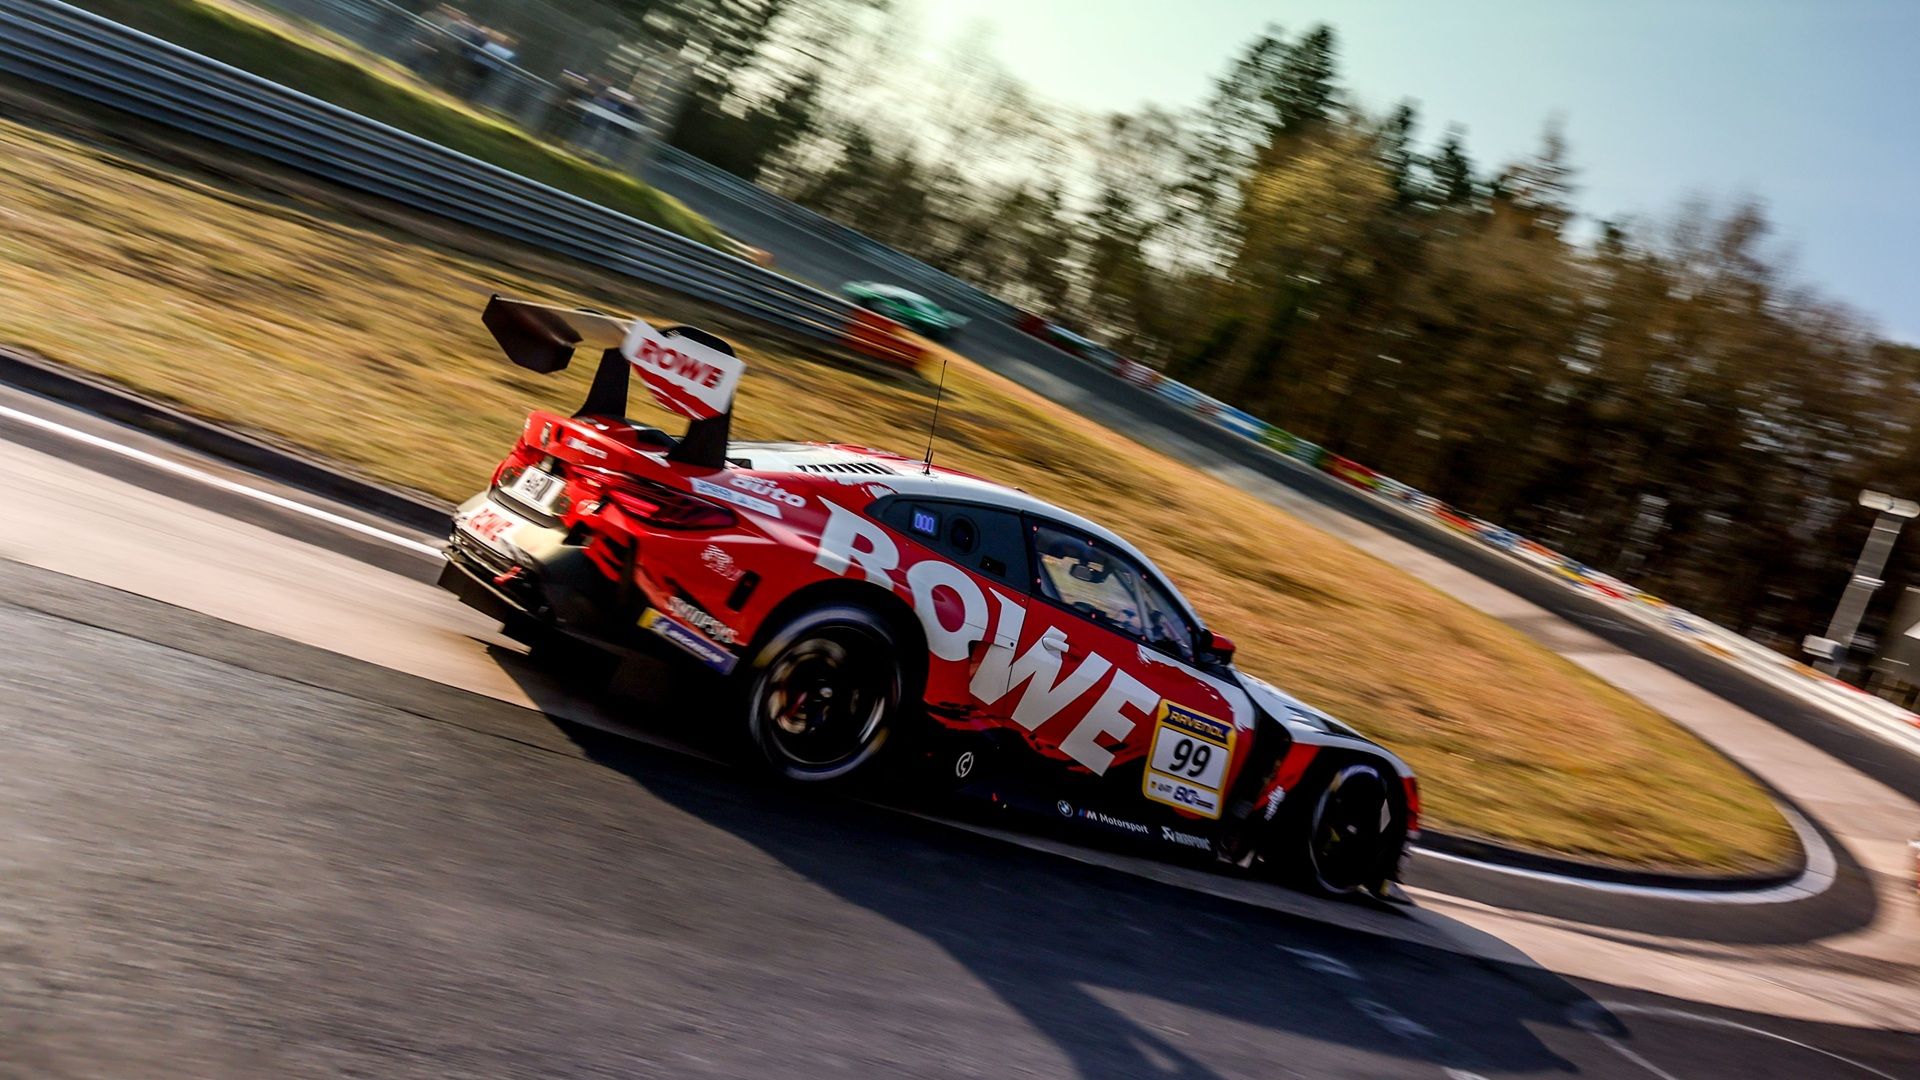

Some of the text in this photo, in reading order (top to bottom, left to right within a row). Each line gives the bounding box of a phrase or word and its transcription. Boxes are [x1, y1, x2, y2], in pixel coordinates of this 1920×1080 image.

[635, 337, 726, 390] ROWE
[729, 478, 806, 508] auto
[813, 495, 1162, 777] ROWE
[1168, 710, 1226, 739] RAVENOL
[1168, 738, 1212, 778] 99
[1099, 812, 1150, 834] Motorsport
